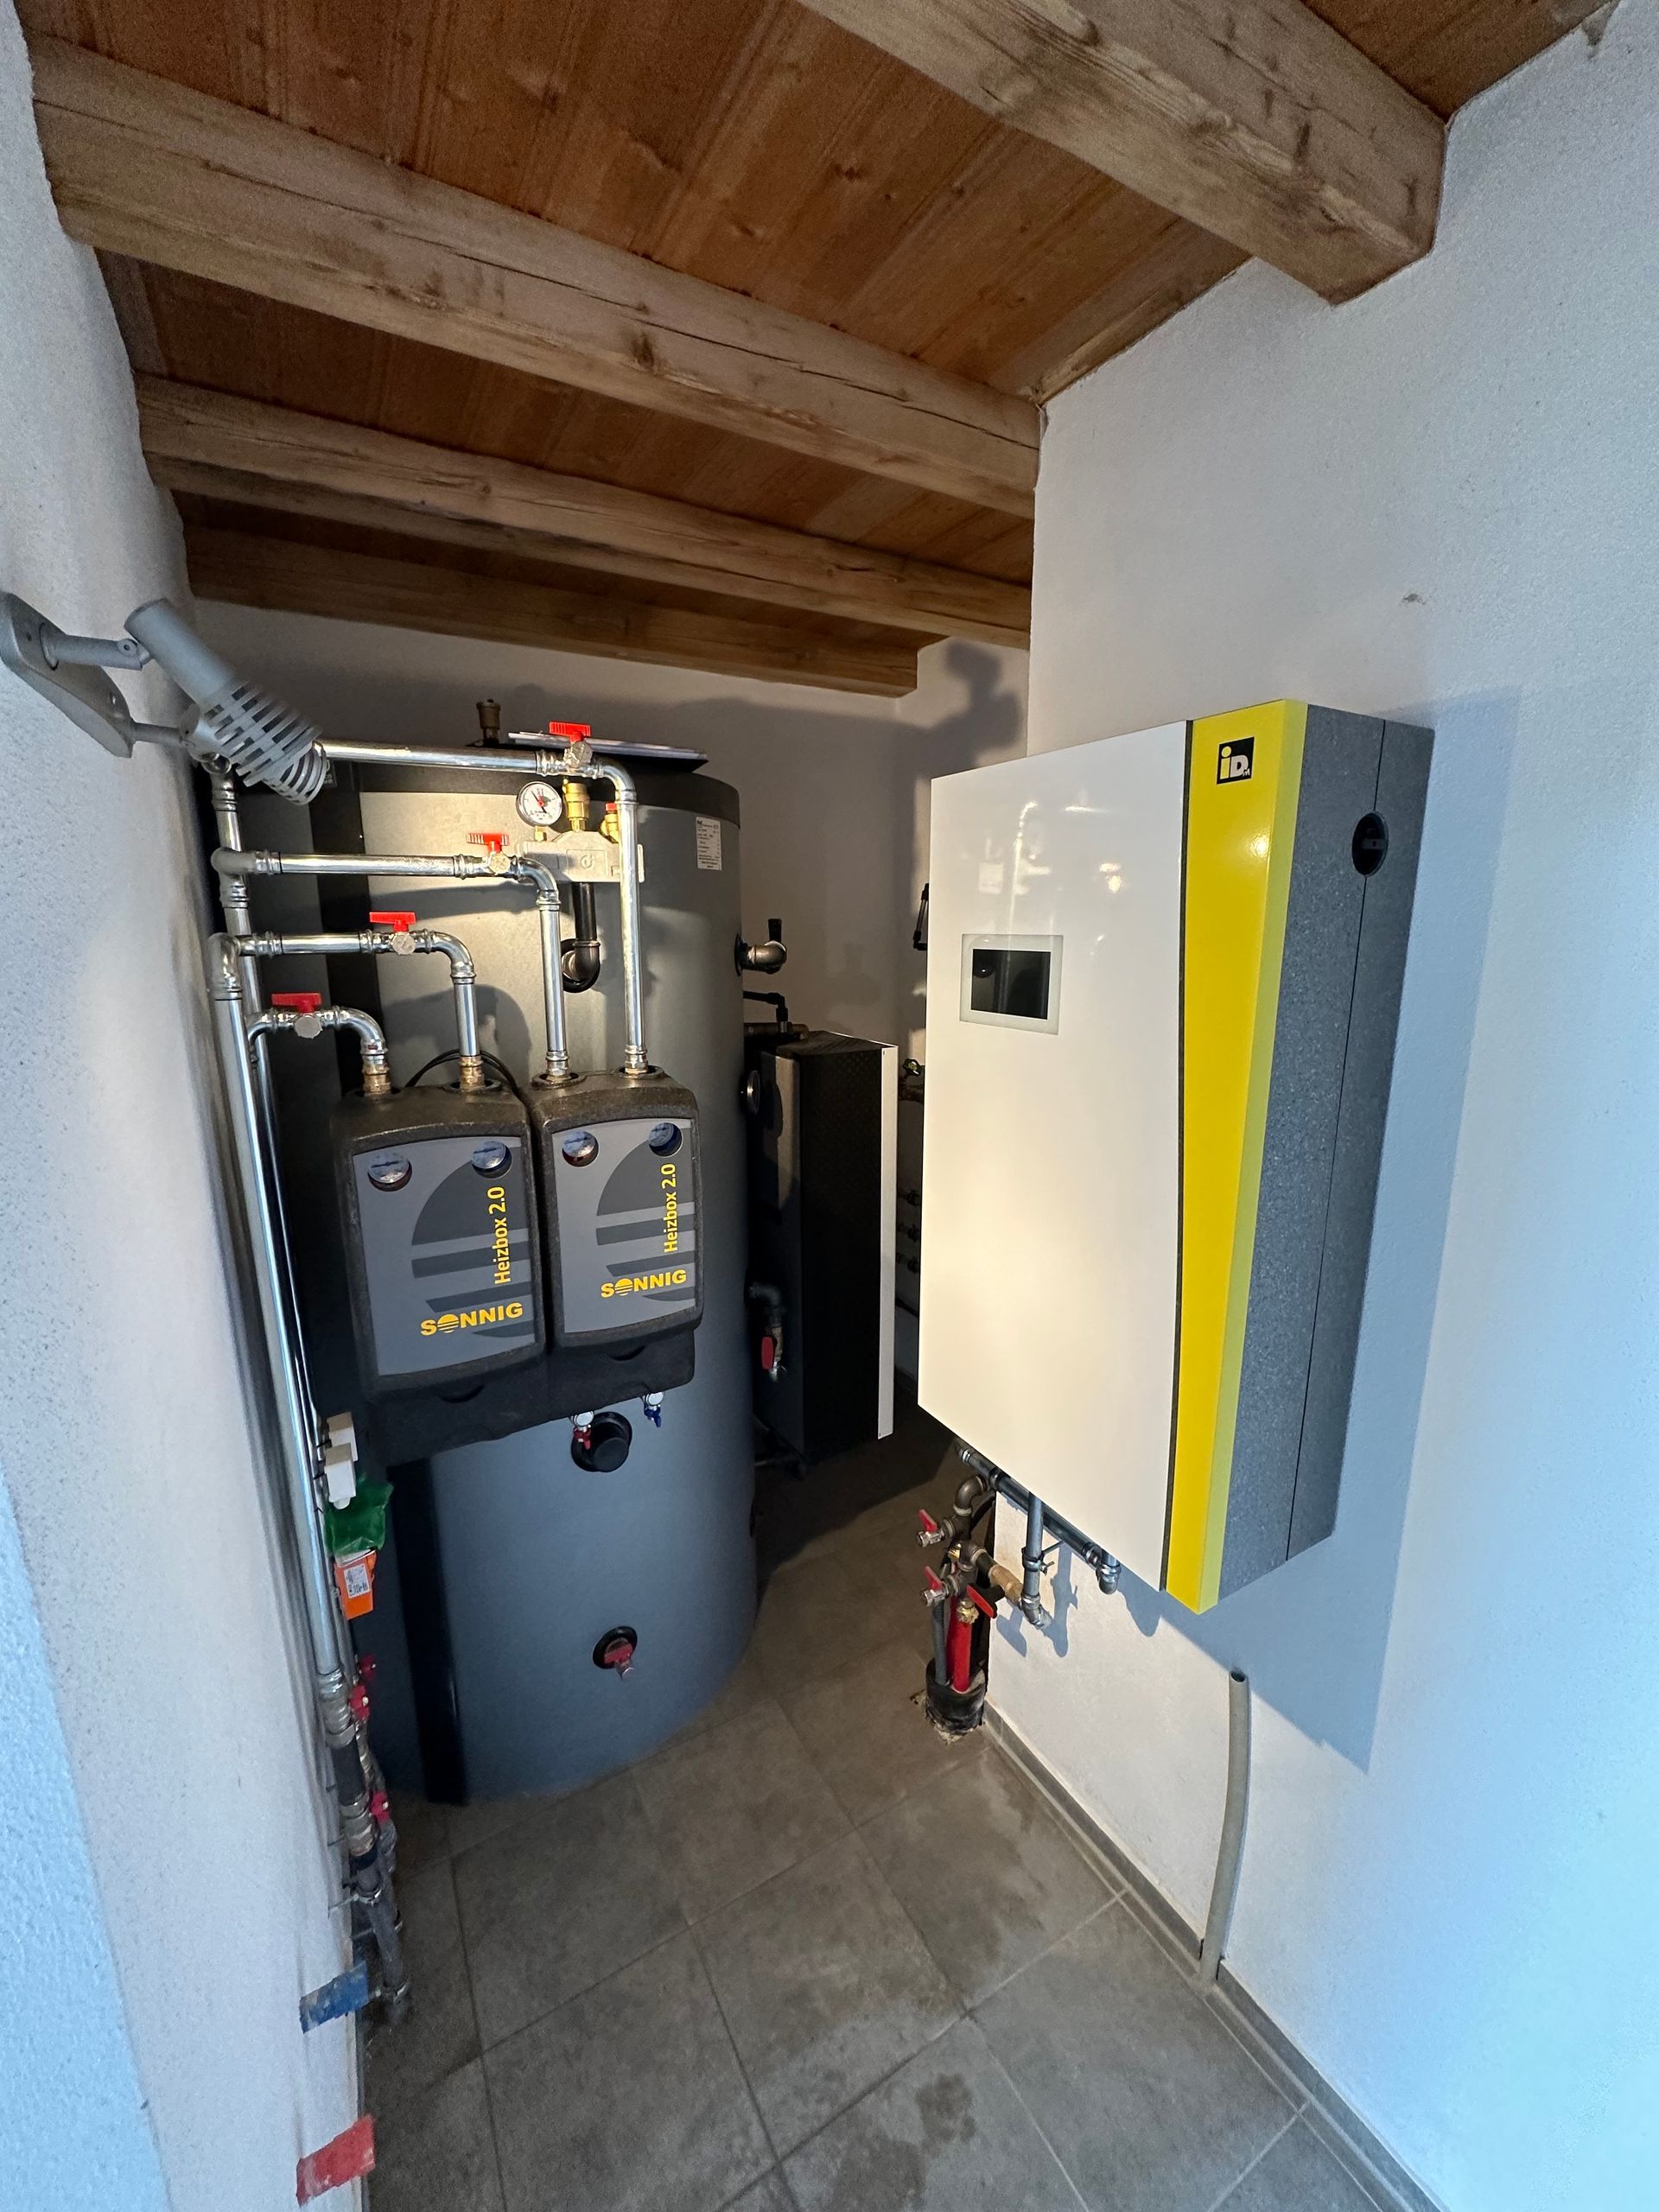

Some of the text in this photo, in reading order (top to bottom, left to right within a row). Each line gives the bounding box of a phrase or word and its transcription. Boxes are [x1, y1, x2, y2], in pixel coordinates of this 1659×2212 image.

[487, 1186, 512, 1285] Heizbox 2.0
[661, 1163, 678, 1253] Heizbox 2.0
[601, 1269, 687, 1298] SONNIG
[421, 1302, 523, 1336] SONNIG
